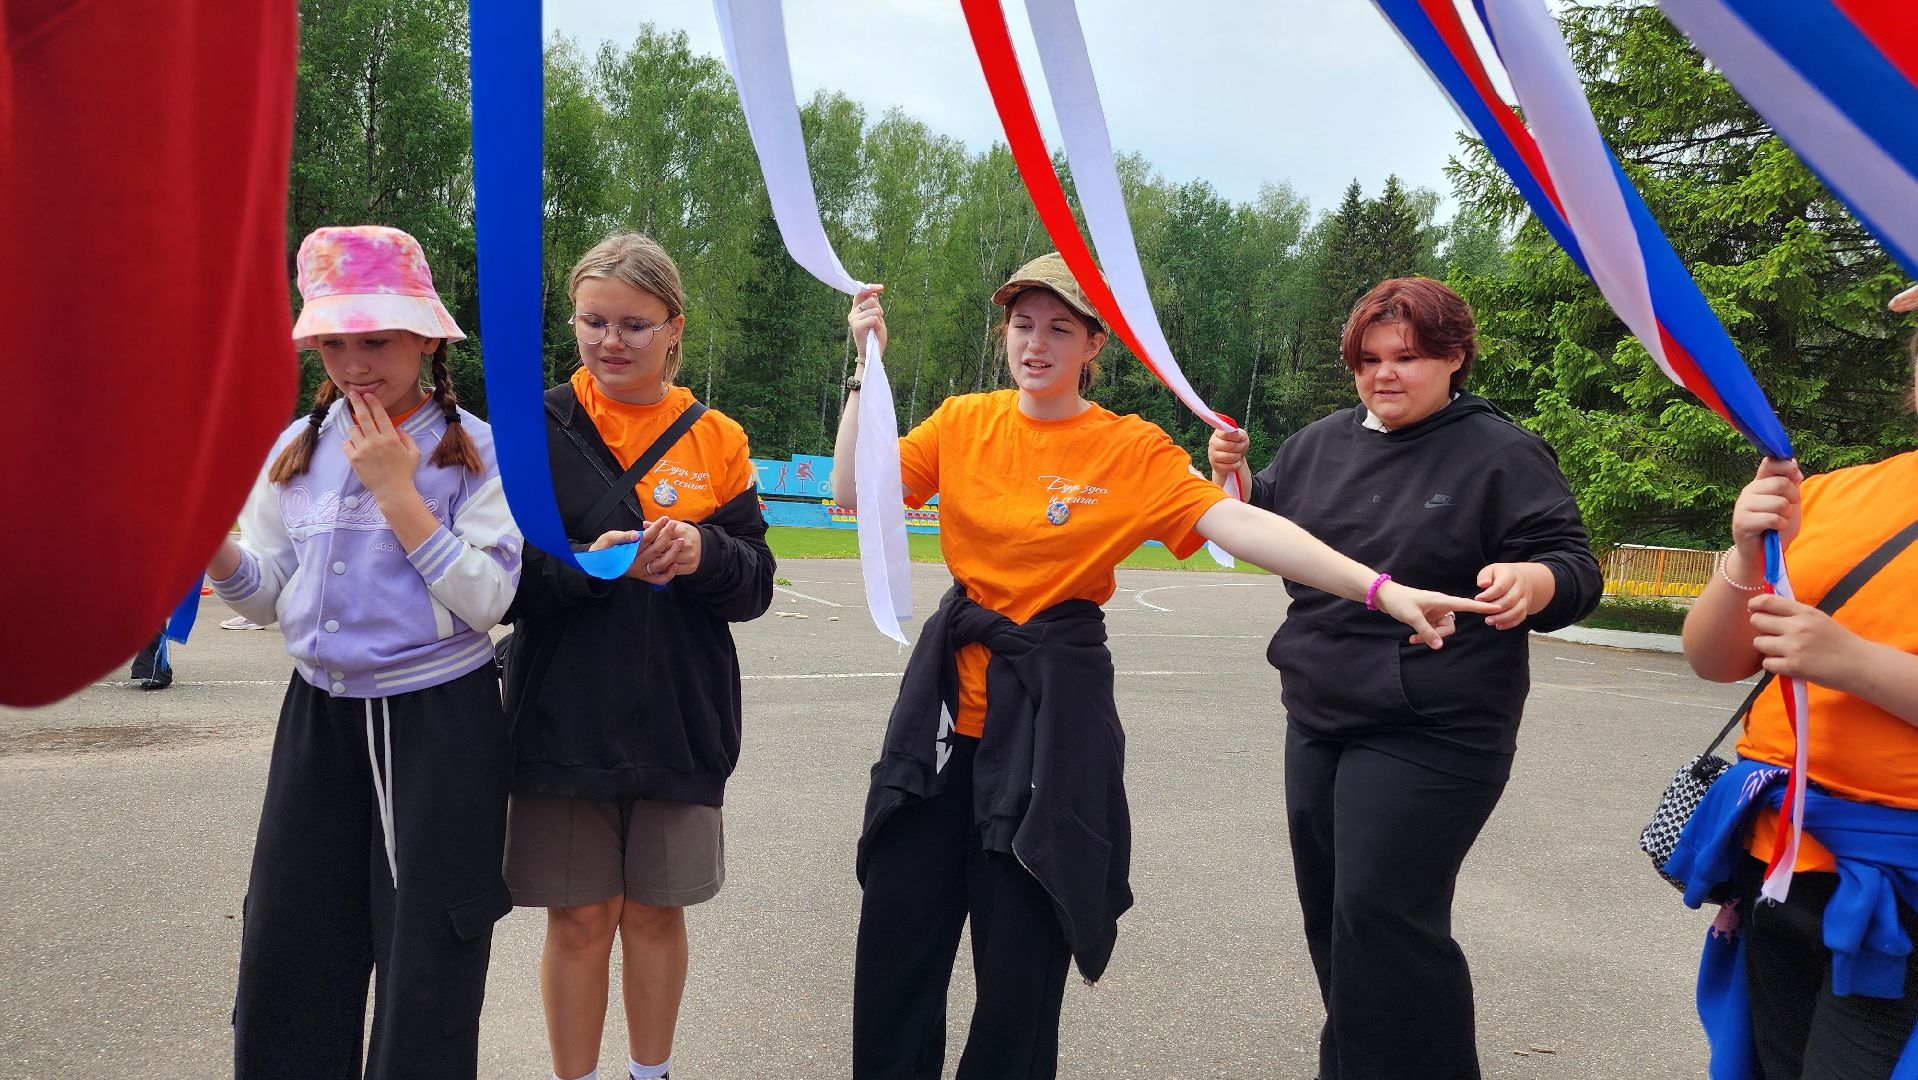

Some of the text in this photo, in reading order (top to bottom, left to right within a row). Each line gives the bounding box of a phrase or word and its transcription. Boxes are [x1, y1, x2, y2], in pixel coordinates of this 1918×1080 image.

[1036, 475, 1109, 494] Будь здесь
[1430, 493, 1455, 504] NIKE
